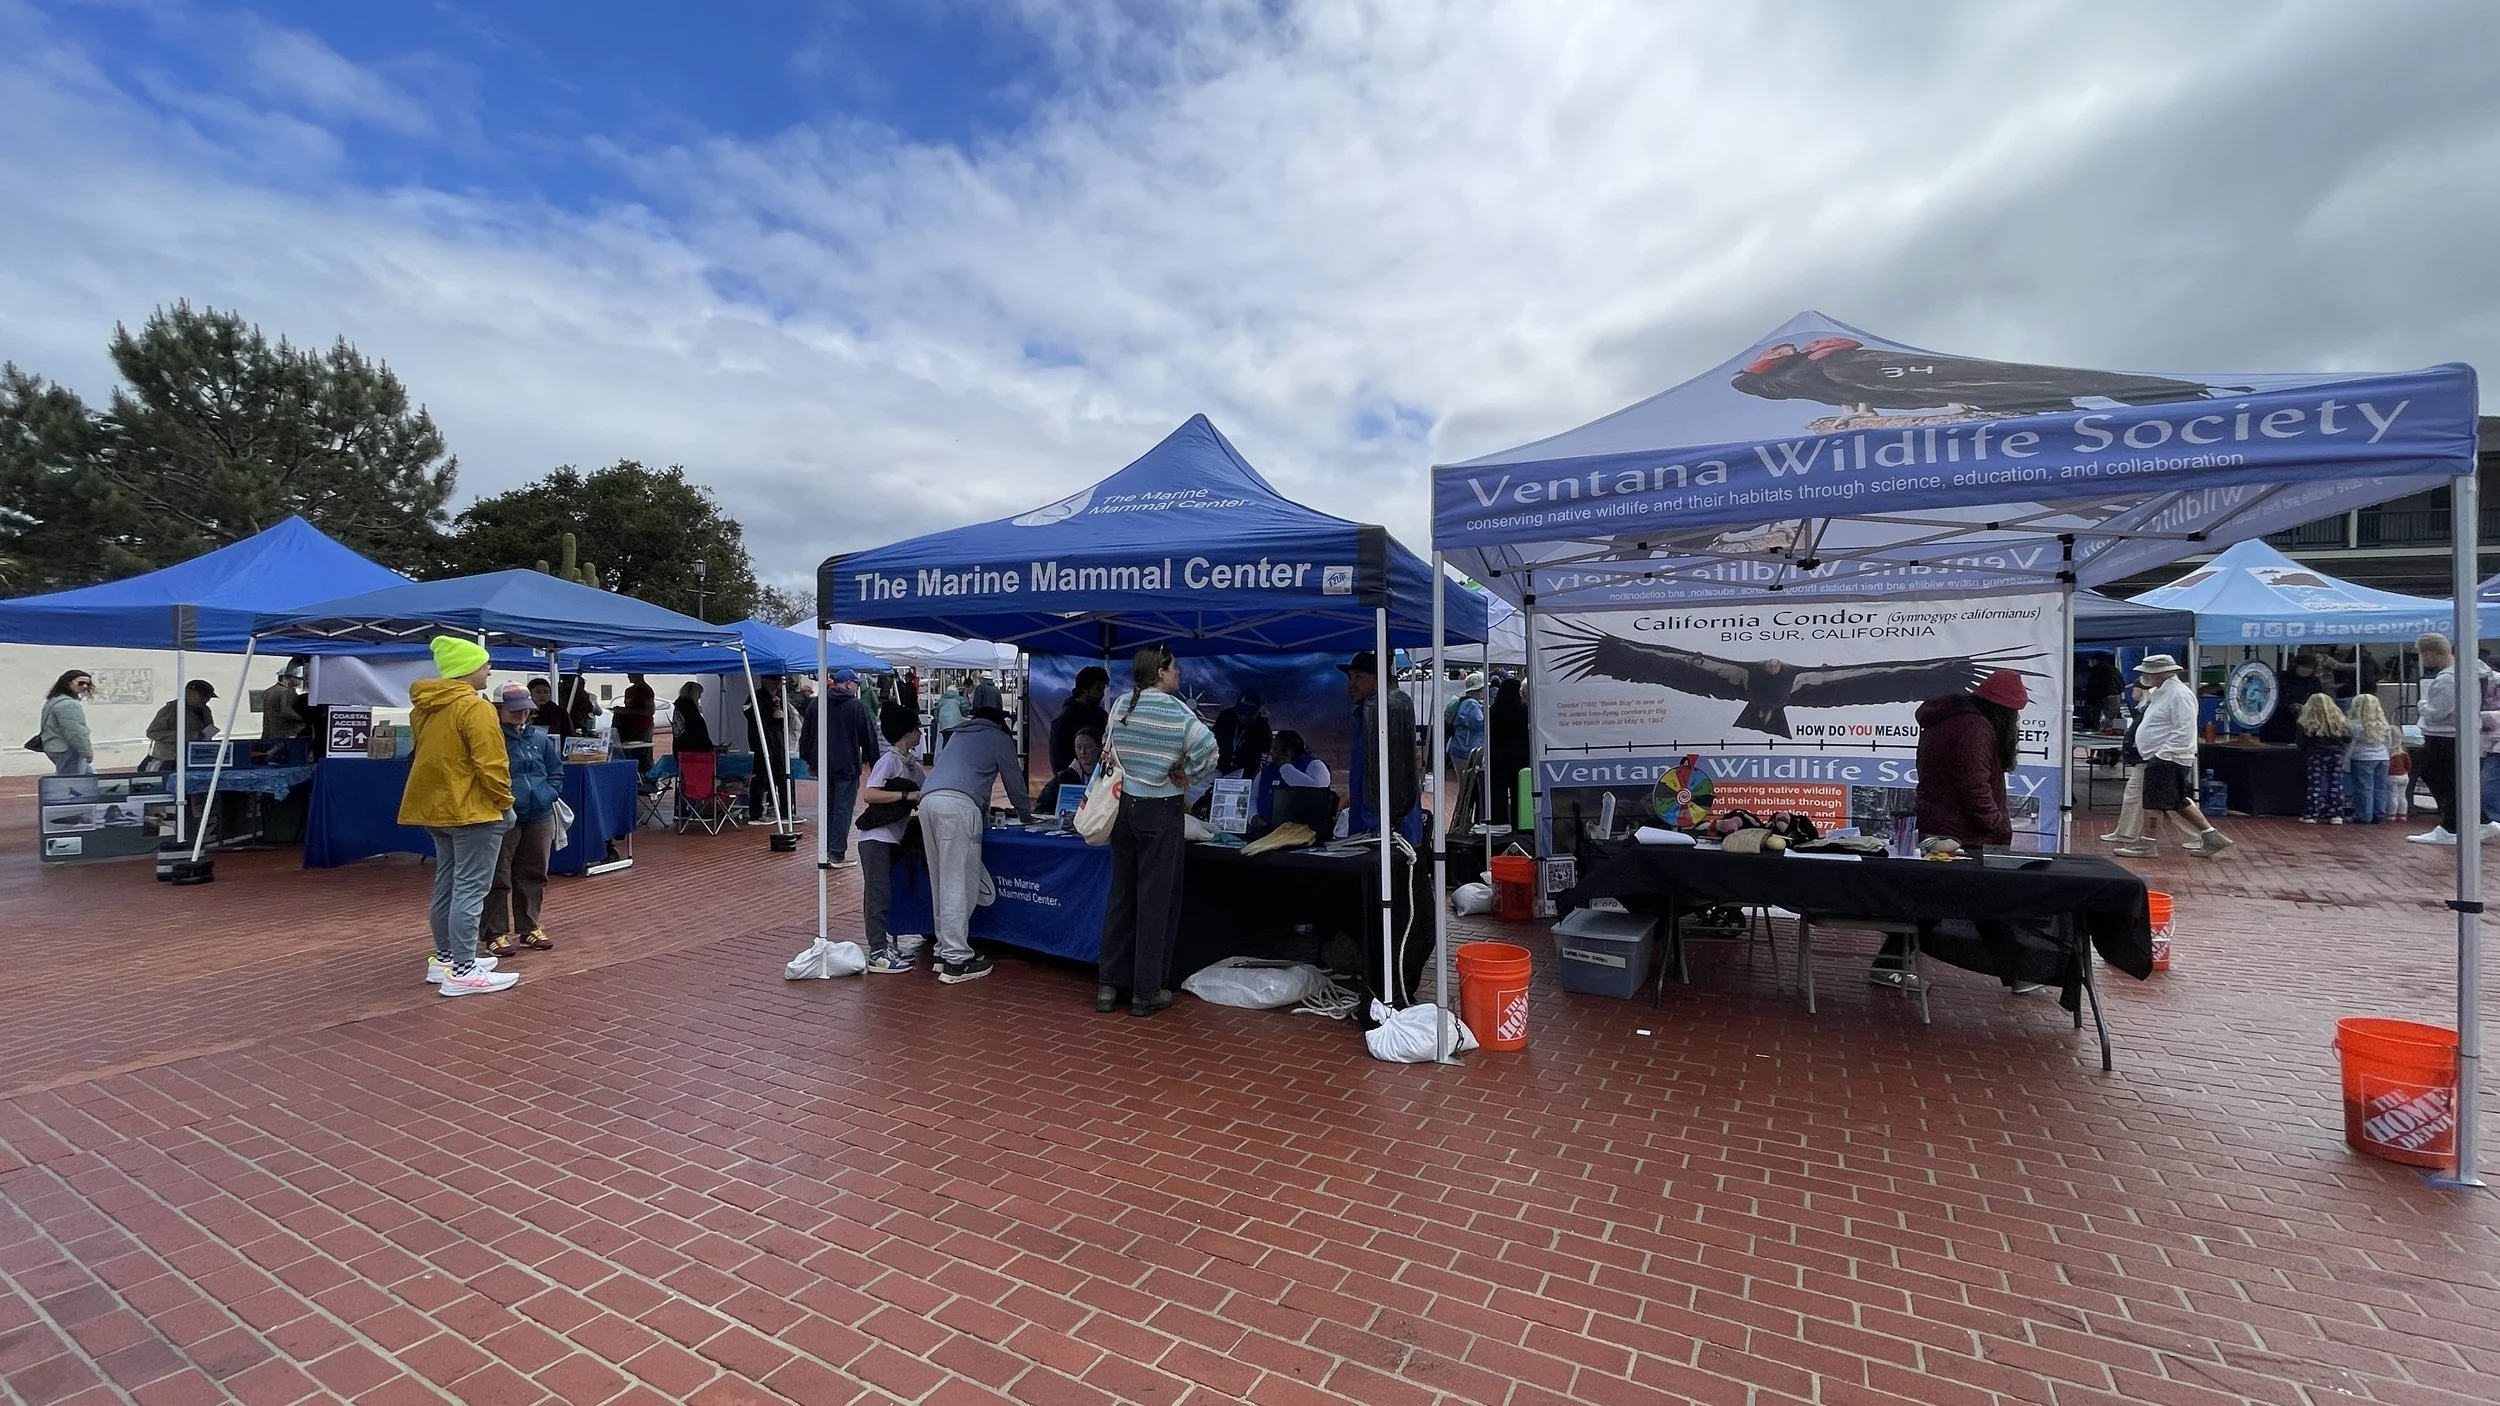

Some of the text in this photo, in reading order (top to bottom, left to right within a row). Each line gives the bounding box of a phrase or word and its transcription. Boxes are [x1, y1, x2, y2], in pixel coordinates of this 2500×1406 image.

[1880, 365, 1934, 379] 34
[1466, 399, 2411, 508] Ventana Wildlife Society
[1103, 488, 1209, 505] The Marine
[1466, 452, 2244, 531] conserving native wildlife and their habitats through science, education, and collaboration
[1088, 501, 1173, 515] Mammal
[855, 556, 1312, 601] The Marine Mammal Center
[1633, 607, 2042, 631] California Condor (Gymnogyps californianus)
[2312, 618, 2482, 635] #saveoursho
[1720, 625, 1936, 642] BIG SUR, CALIFORNIA
[1796, 724, 2050, 743] HOW DO YOU MEASU EET?
[1546, 762, 1671, 782] Ventan
[1708, 758, 1862, 781] Wildlife
[1713, 785, 1842, 796] onserving native wildlife
[1712, 797, 1842, 808] nd their habitats through
[996, 876, 1040, 891] The Marine
[998, 888, 1032, 901] Mammal
[1504, 994, 1523, 1016] THE
[2374, 1089, 2410, 1112] THE
[2364, 1087, 2450, 1142] HOME
[2400, 1112, 2455, 1149] DEPOT
